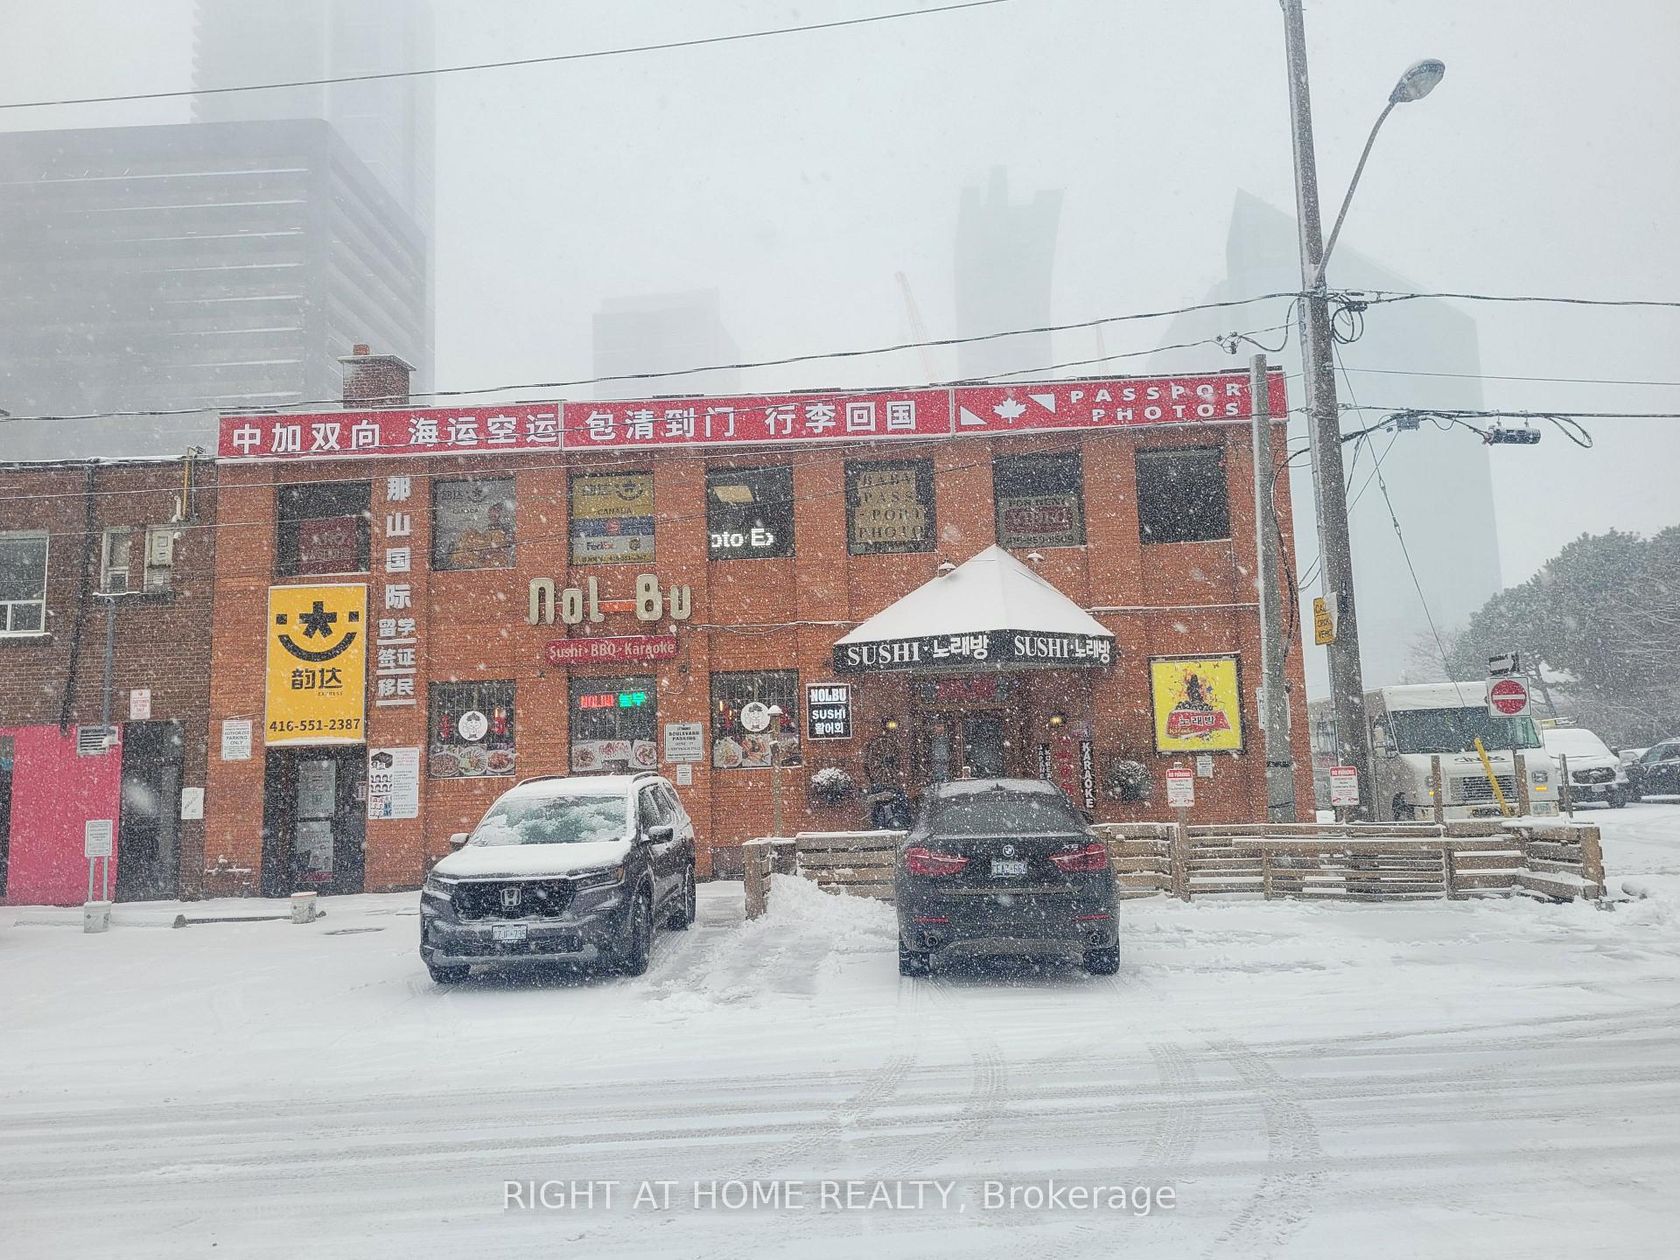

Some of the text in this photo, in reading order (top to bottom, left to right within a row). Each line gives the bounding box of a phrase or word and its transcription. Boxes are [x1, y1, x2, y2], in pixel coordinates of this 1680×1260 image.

[1070, 384, 1242, 404] PASSPOR
[1092, 402, 1239, 422] PHOTOS
[232, 400, 916, 454] 中加双向 海运空运 包清到门 行李回国
[386, 477, 412, 609] 那山国际
[378, 618, 416, 637] 留学
[378, 649, 416, 668] 签证
[550, 642, 675, 659] Sushi BBQ Karaoke
[847, 635, 990, 666] SUSHI 노래방
[1014, 635, 1110, 664] SUSHI 노래방
[291, 668, 343, 690] 韵达
[378, 678, 416, 698] 移民
[811, 688, 847, 702] NOLBU
[812, 709, 846, 720] SUSHI
[269, 718, 361, 733] 416-551-2387
[1082, 741, 1094, 808] KARAOKE
